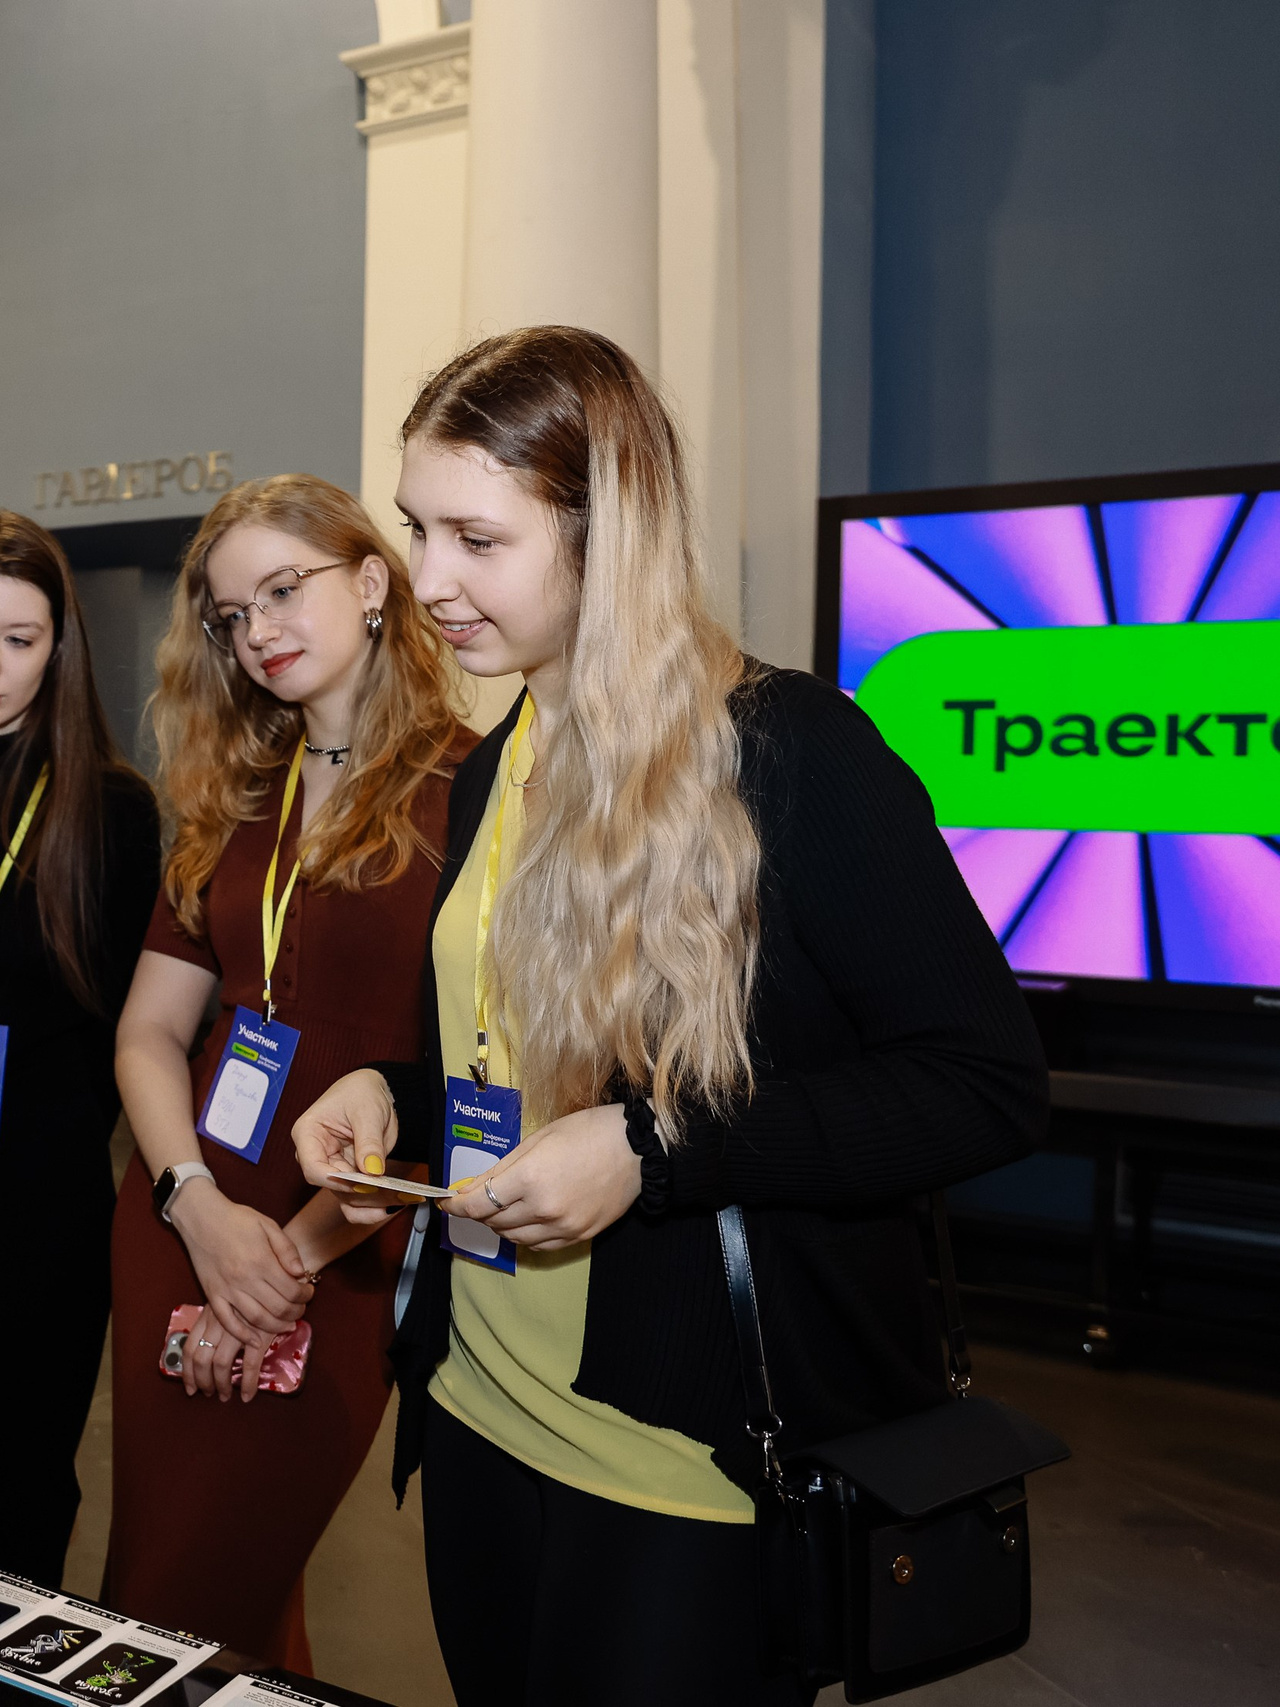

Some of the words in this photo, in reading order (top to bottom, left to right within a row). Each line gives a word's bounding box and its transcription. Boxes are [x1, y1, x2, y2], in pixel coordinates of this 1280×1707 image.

[944, 698, 1280, 772] Траект
[238, 1023, 279, 1051] Участник
[453, 1099, 501, 1123] Участник
